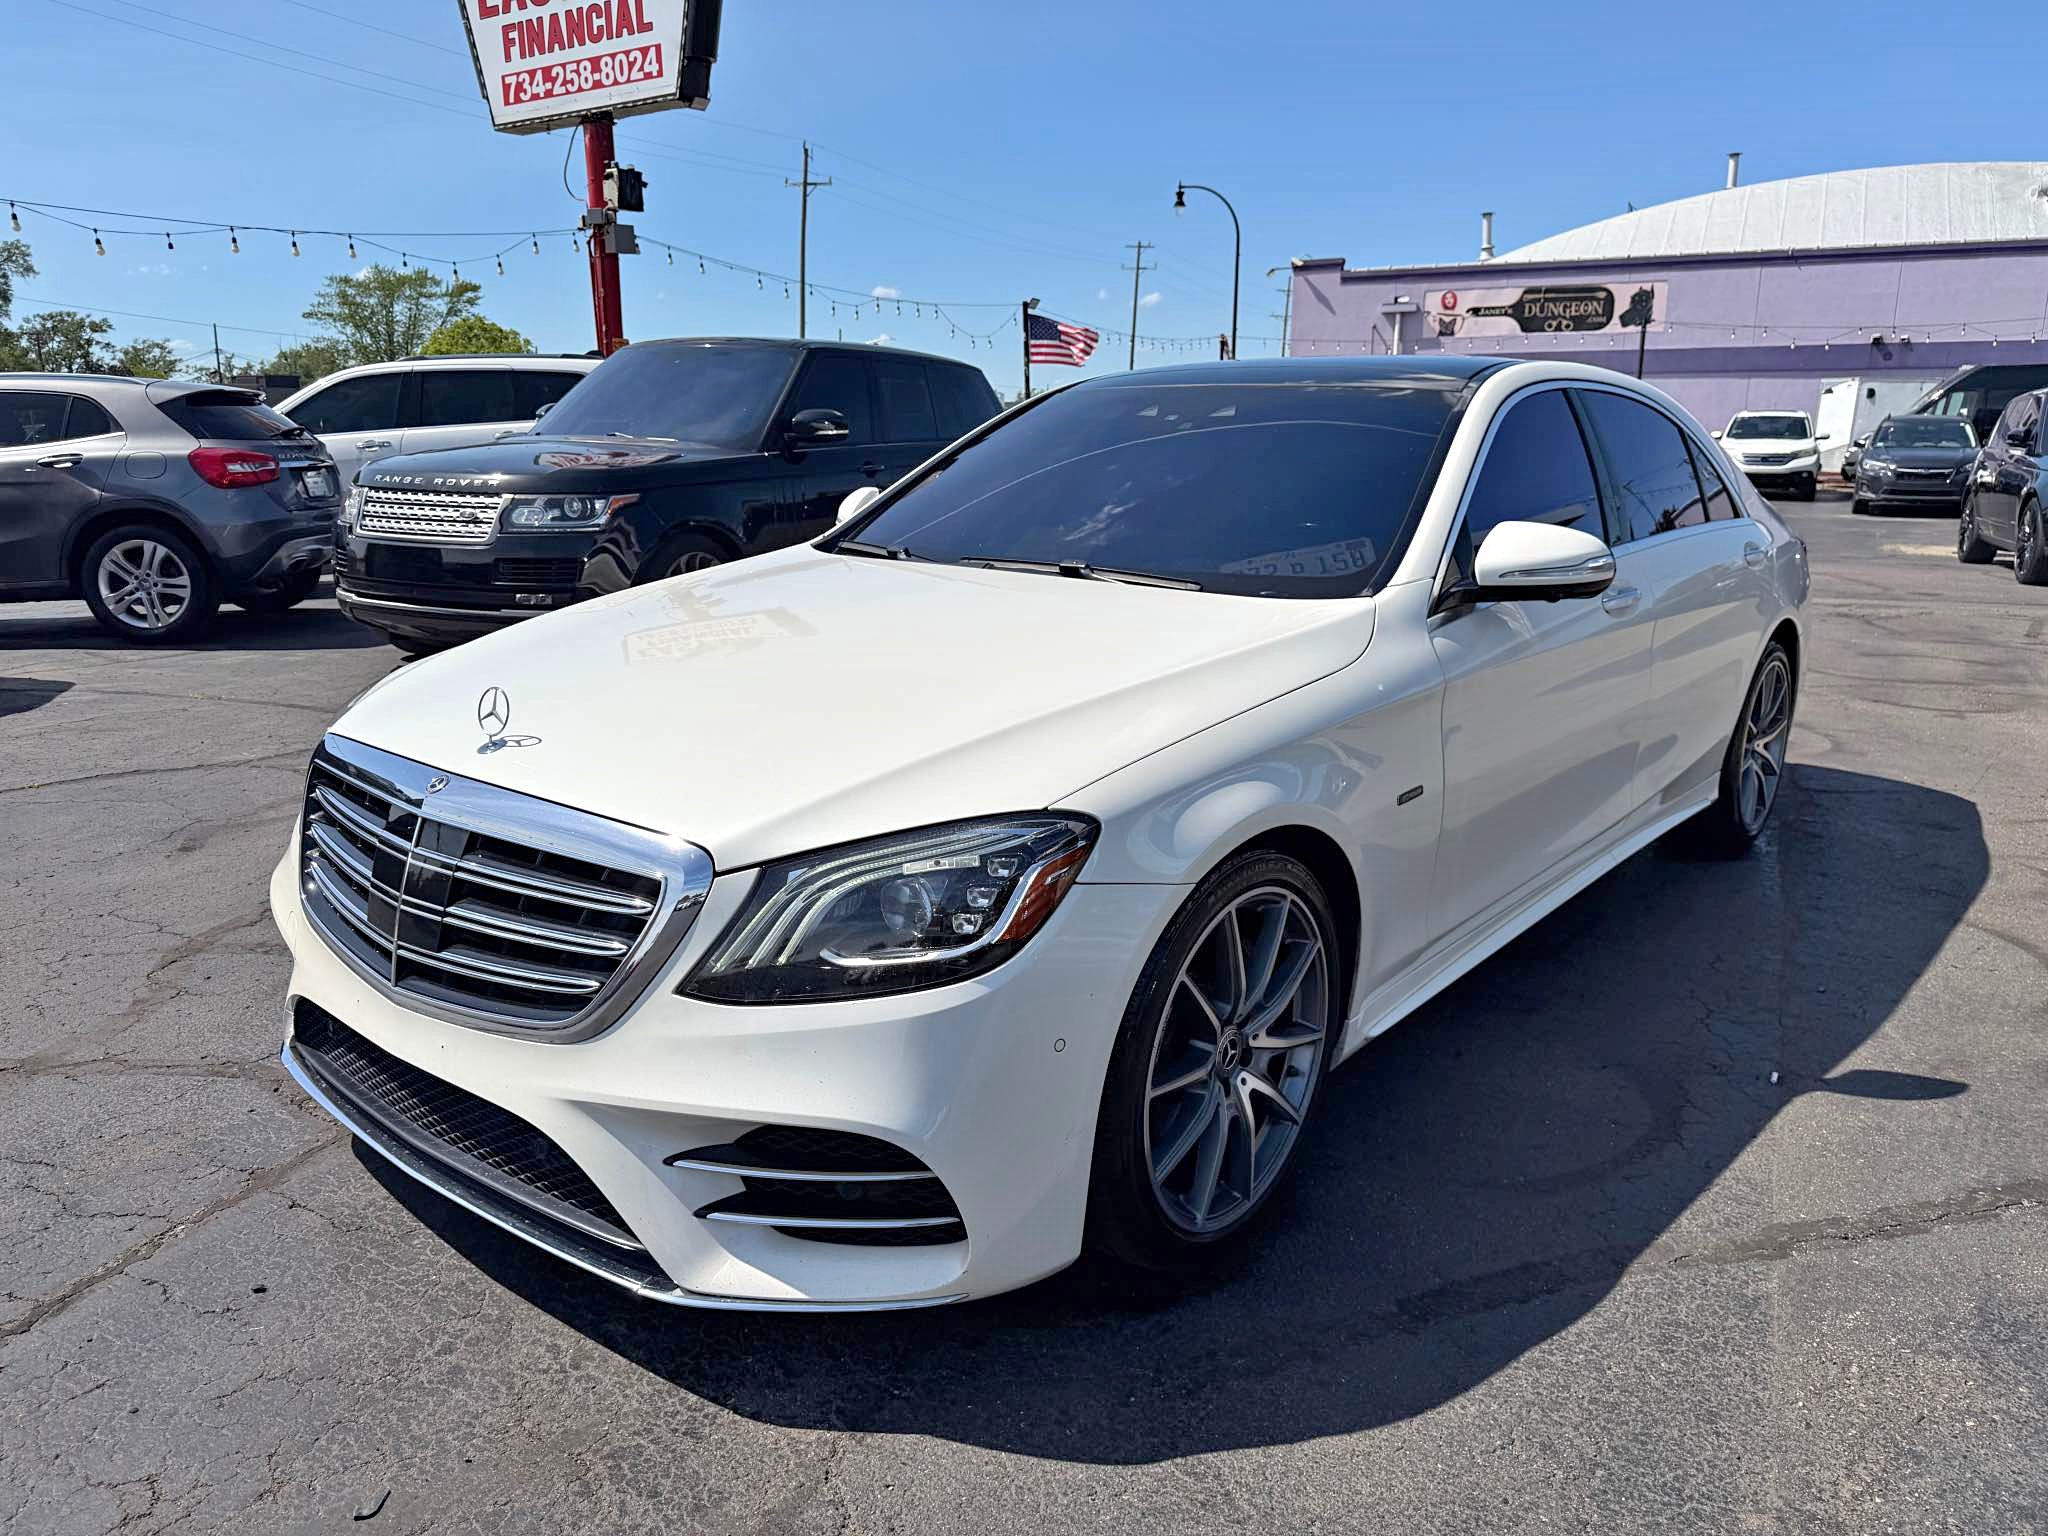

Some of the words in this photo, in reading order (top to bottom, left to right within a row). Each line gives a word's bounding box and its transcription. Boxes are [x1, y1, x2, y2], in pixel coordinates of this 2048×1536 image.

[502, 0, 654, 63] FINANCIAL
[504, 47, 661, 104] 734-258-8024
[1524, 300, 1604, 319] DUNGEON
[374, 474, 424, 484] RANGE
[433, 477, 502, 487] ROVER
